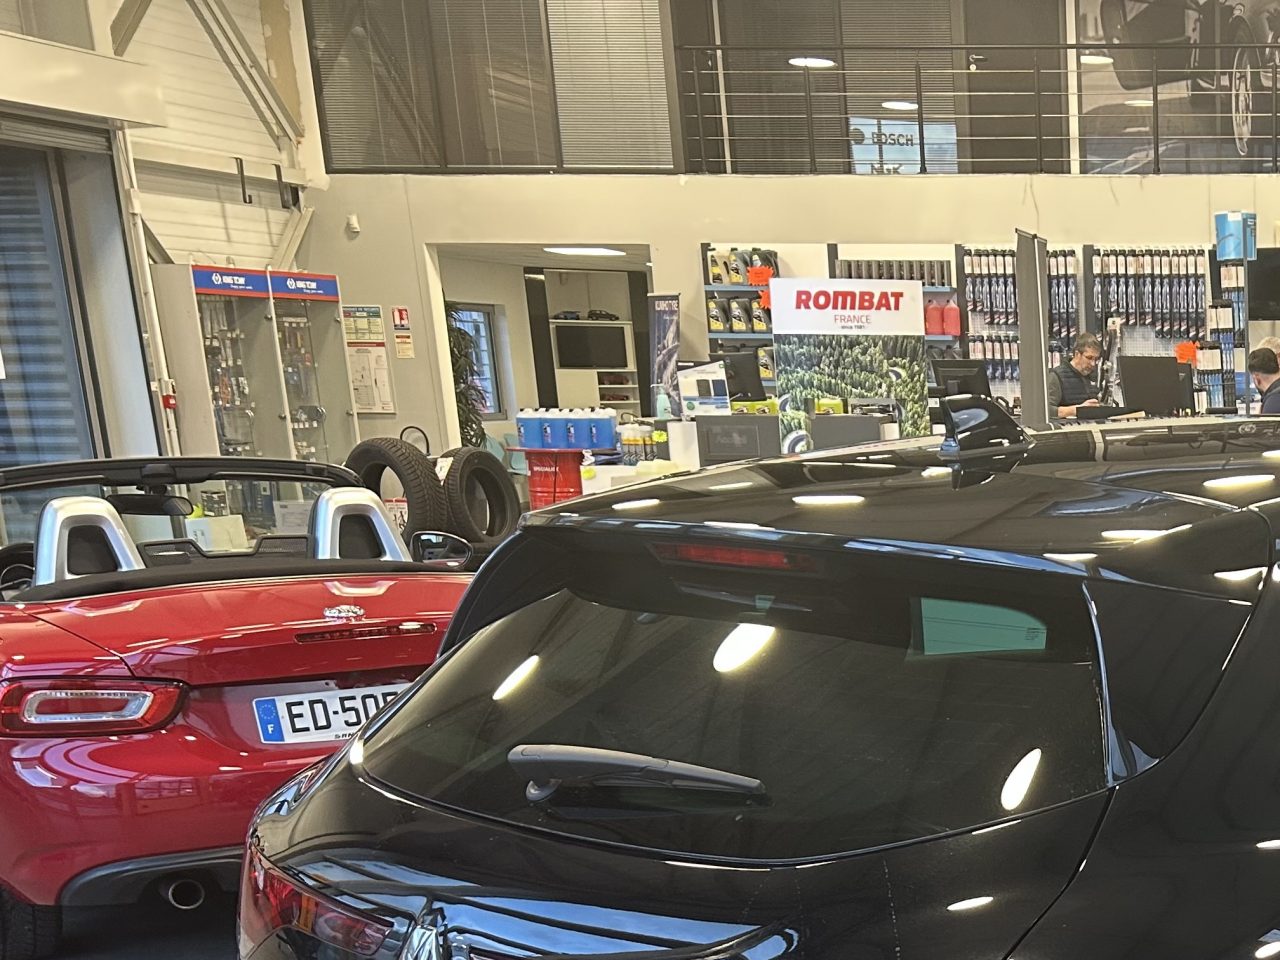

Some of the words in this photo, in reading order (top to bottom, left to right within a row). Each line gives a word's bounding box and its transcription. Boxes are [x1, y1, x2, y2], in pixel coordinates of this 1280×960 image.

[795, 290, 904, 311] ROMBAT
[834, 315, 872, 324] FRANCE
[266, 724, 275, 734] F
